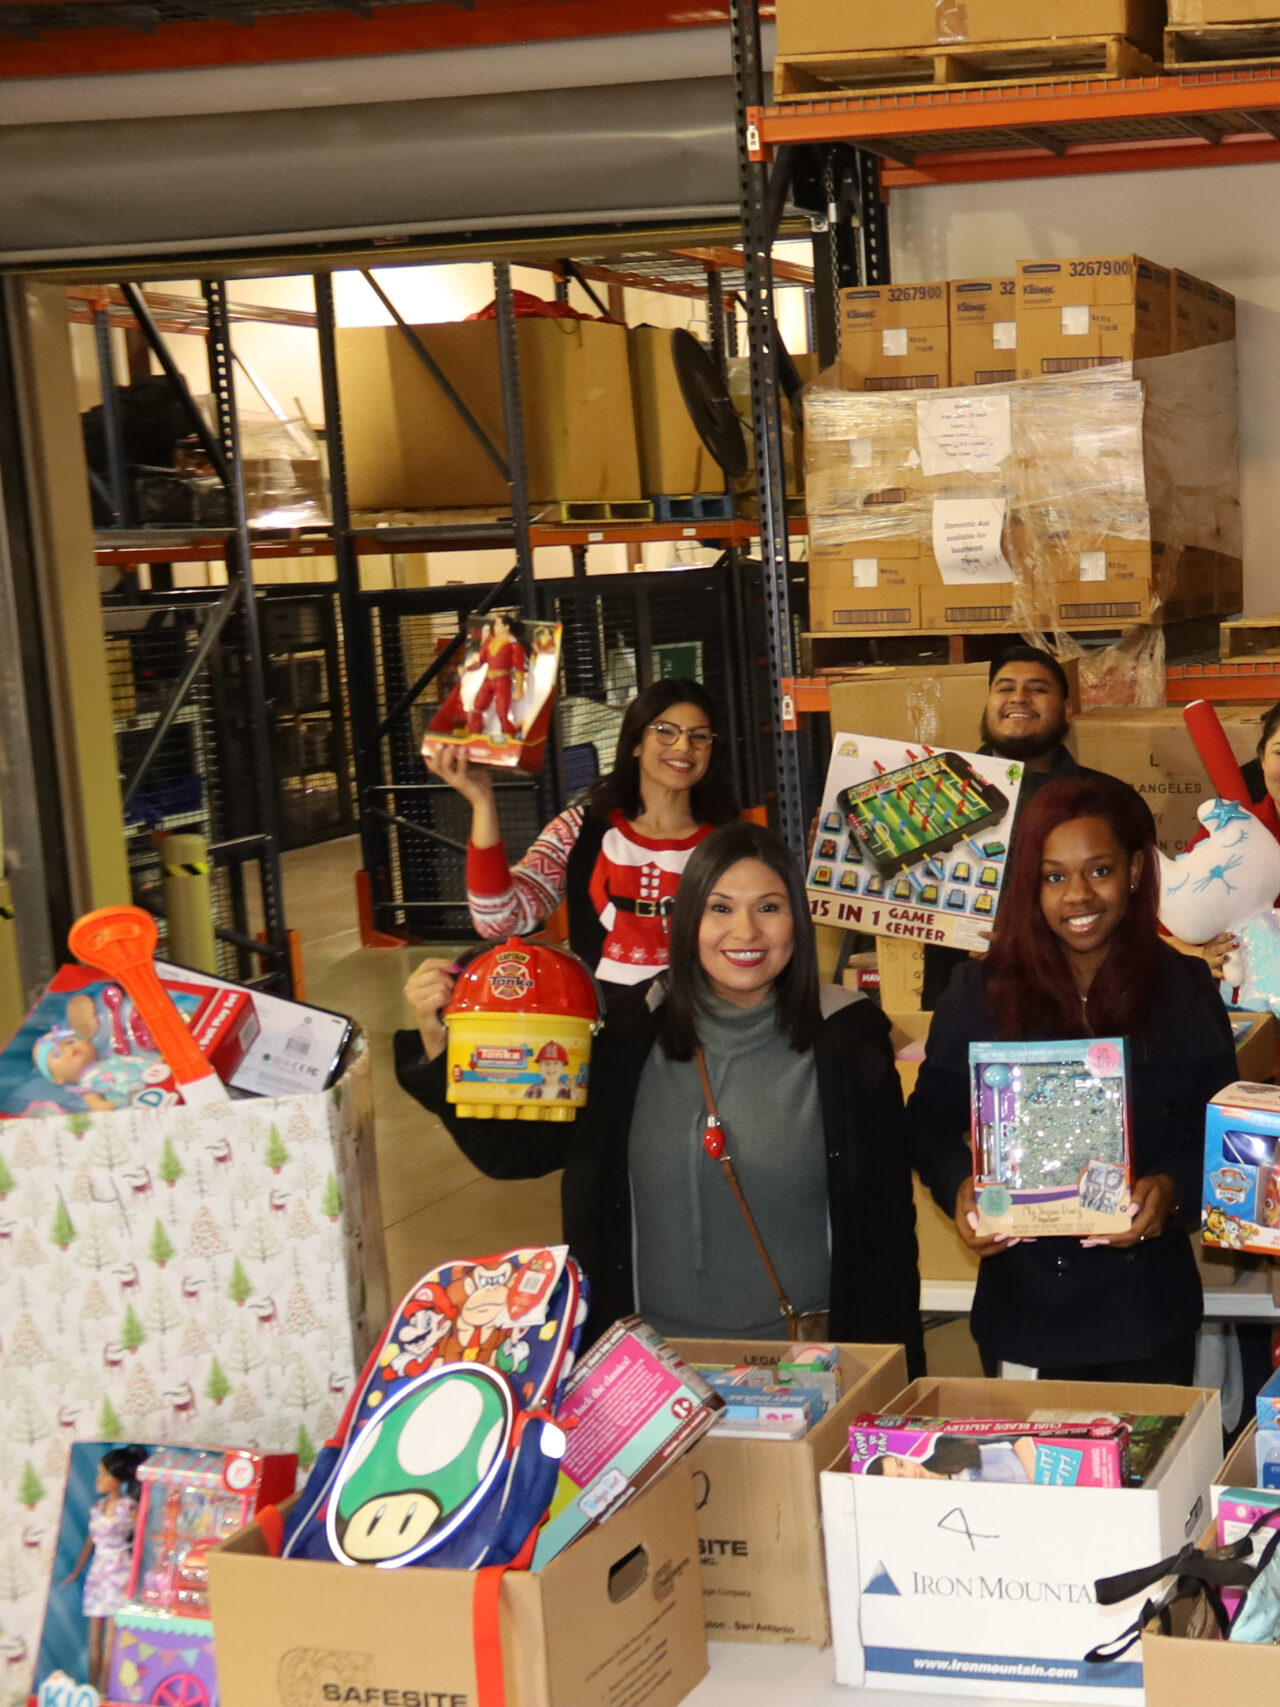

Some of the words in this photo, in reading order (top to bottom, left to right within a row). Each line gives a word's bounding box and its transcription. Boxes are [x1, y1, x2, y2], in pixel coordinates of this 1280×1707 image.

[1139, 783, 1202, 794] ANGELES
[810, 899, 831, 917] 15
[837, 903, 863, 923] IN
[871, 909, 881, 926] 1
[888, 907, 935, 926] GAME
[885, 921, 946, 942] CENTER
[489, 976, 534, 989] Tonka
[480, 1048, 521, 1060] Tonka
[674, 1400, 691, 1417] 1+
[698, 1538, 749, 1557] SITE
[912, 1571, 973, 1598] IRON
[978, 1575, 1097, 1605] MOUNTA
[913, 1658, 1079, 1679] www.ironmountain.com
[323, 1683, 468, 1707] SAFESITE
